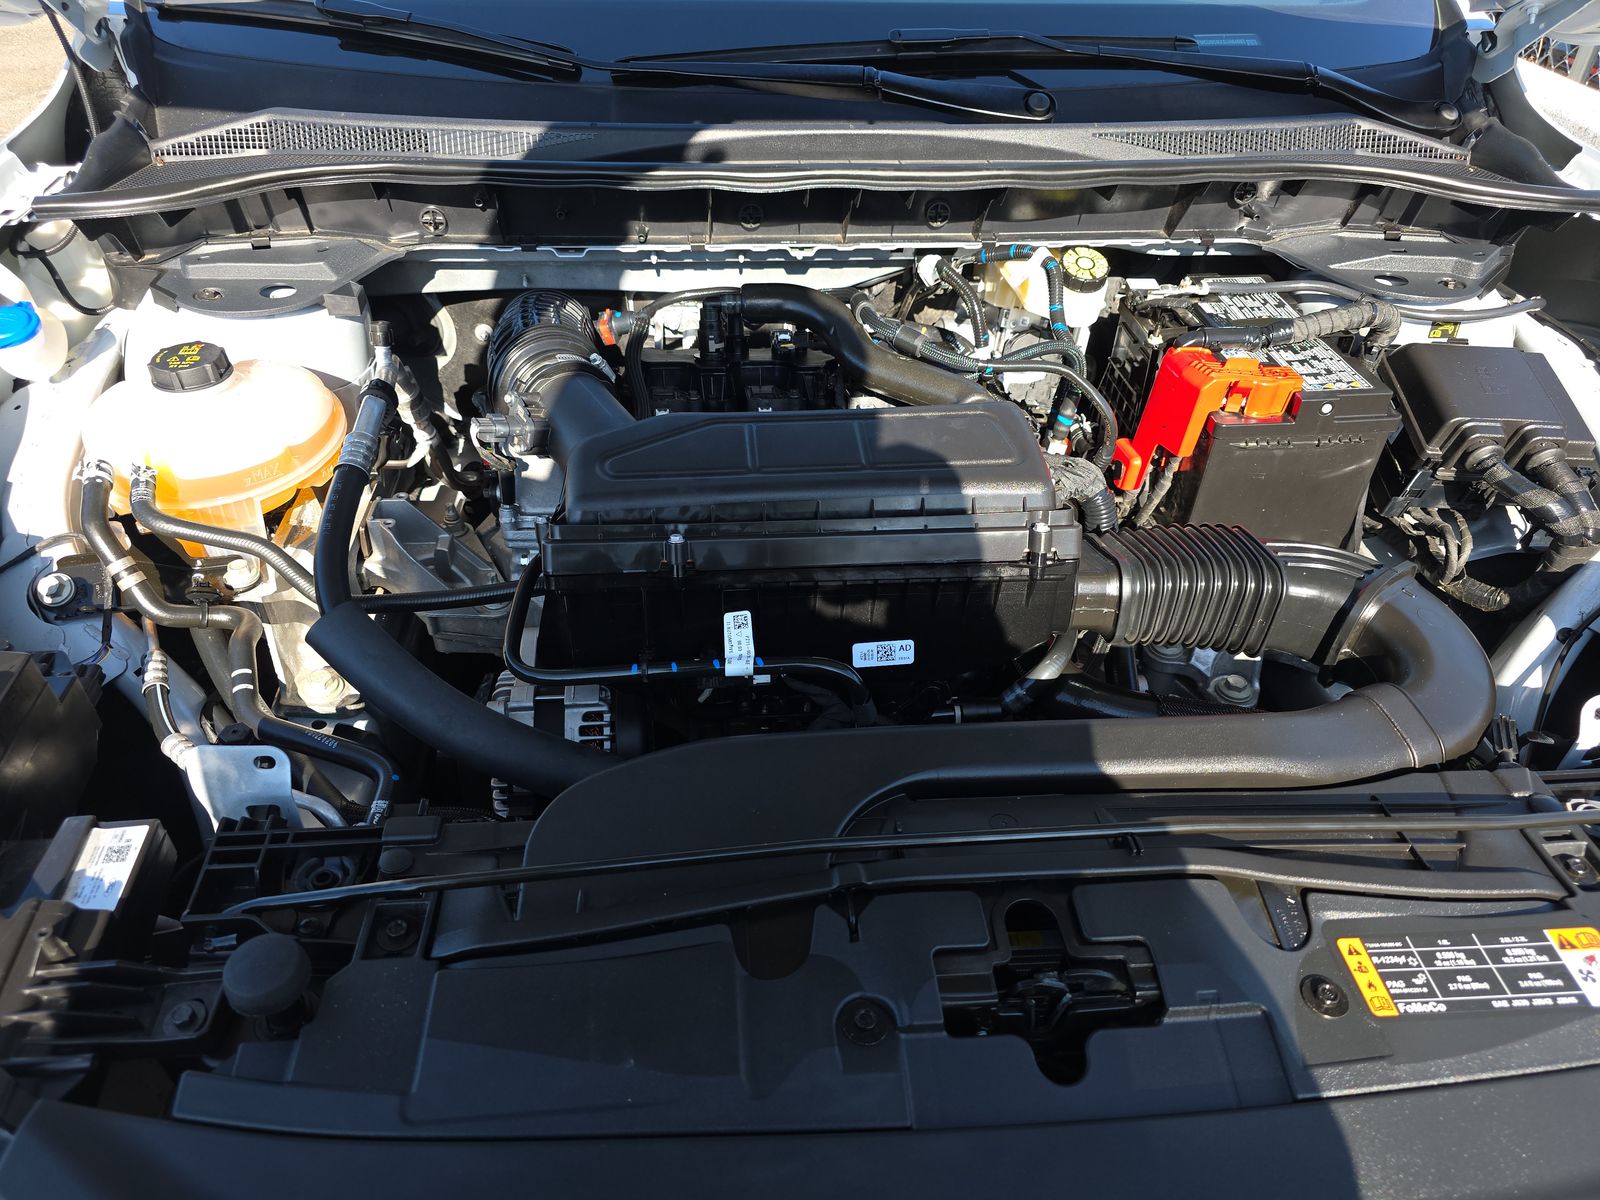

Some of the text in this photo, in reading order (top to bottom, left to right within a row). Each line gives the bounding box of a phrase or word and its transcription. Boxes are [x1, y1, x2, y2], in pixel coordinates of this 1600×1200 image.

[898, 644, 912, 652] AD
[1385, 980, 1406, 989] PAG
[1397, 1002, 1447, 1013] FoMoCo
